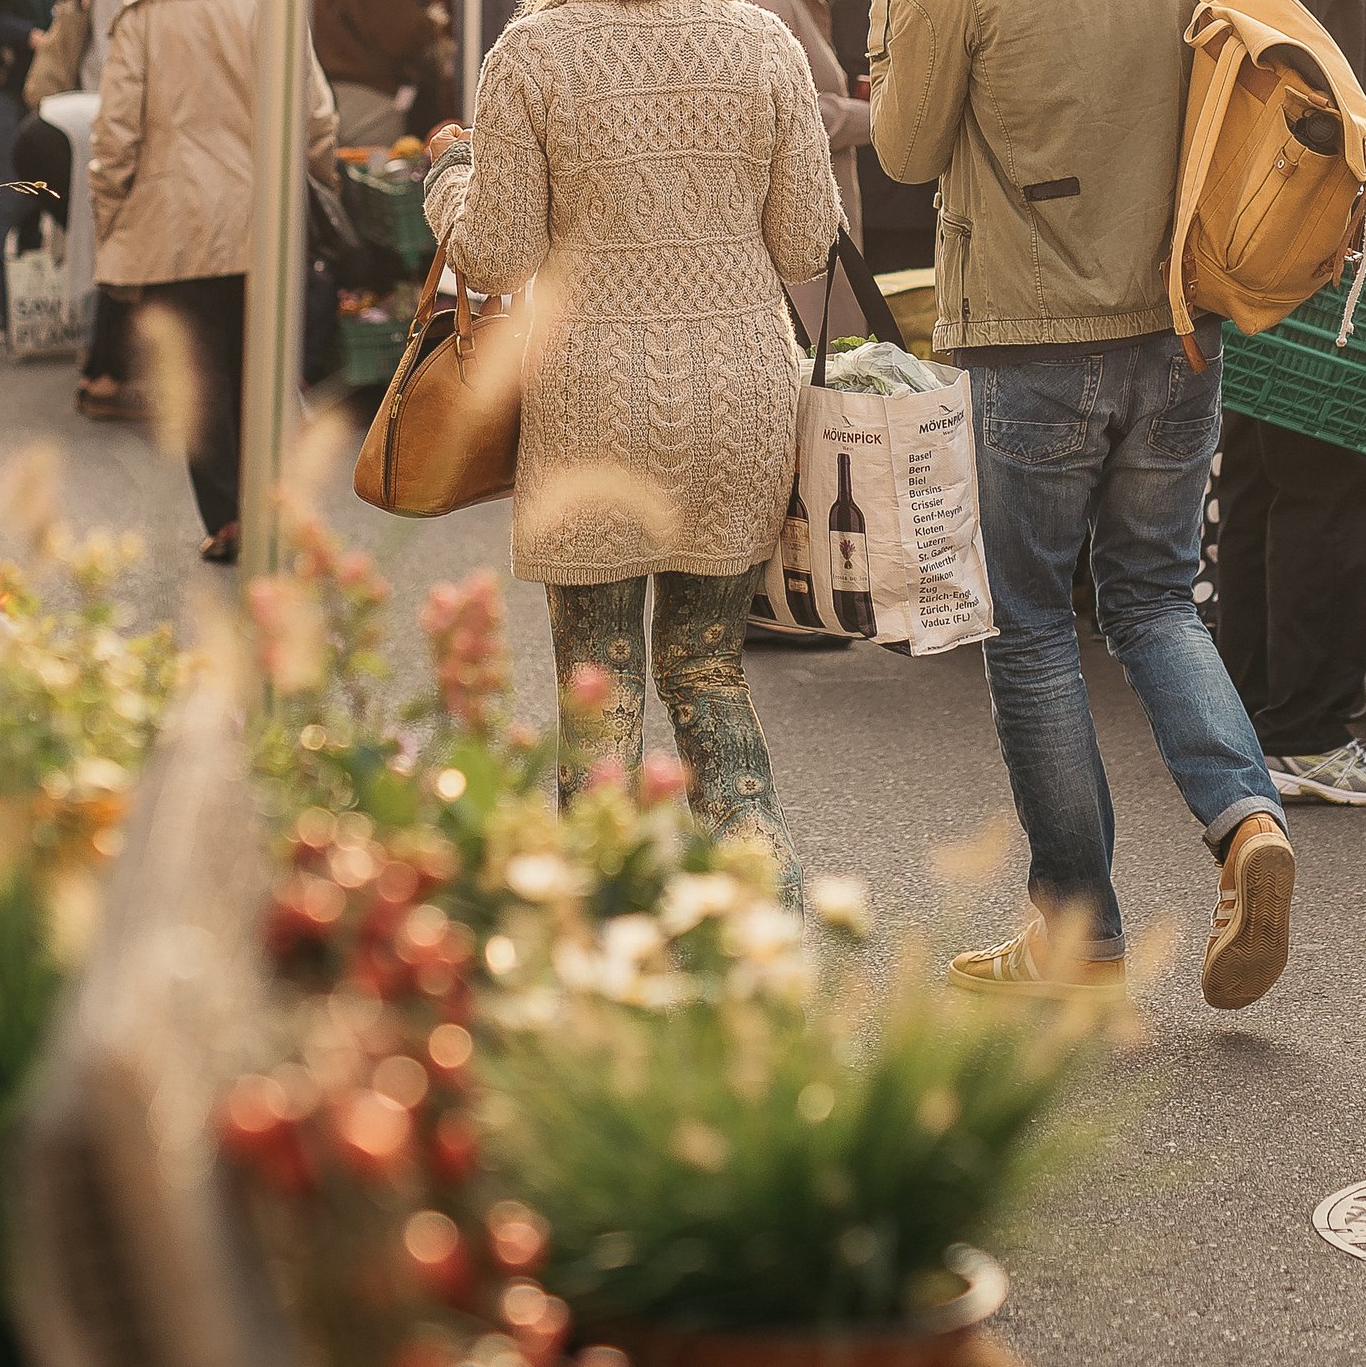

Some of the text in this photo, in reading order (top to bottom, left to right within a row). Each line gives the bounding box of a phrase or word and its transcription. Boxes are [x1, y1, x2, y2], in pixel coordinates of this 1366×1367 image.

[919, 410, 965, 435] MÖVENPICK
[823, 428, 883, 445] MÖVENPICK
[909, 451, 932, 463] Basel
[909, 465, 931, 475] Bern
[909, 477, 926, 486] Biel
[909, 485, 942, 498] Bursins
[911, 498, 944, 511] Crissier
[913, 505, 962, 523] Genf-Meyrin
[915, 525, 943, 537] Kloten
[917, 537, 945, 549] Luzern
[919, 553, 930, 563] St.
[919, 570, 953, 585] Zollikon
[920, 603, 953, 616] Zürich,
[921, 613, 971, 629] Vaduz (FL)
